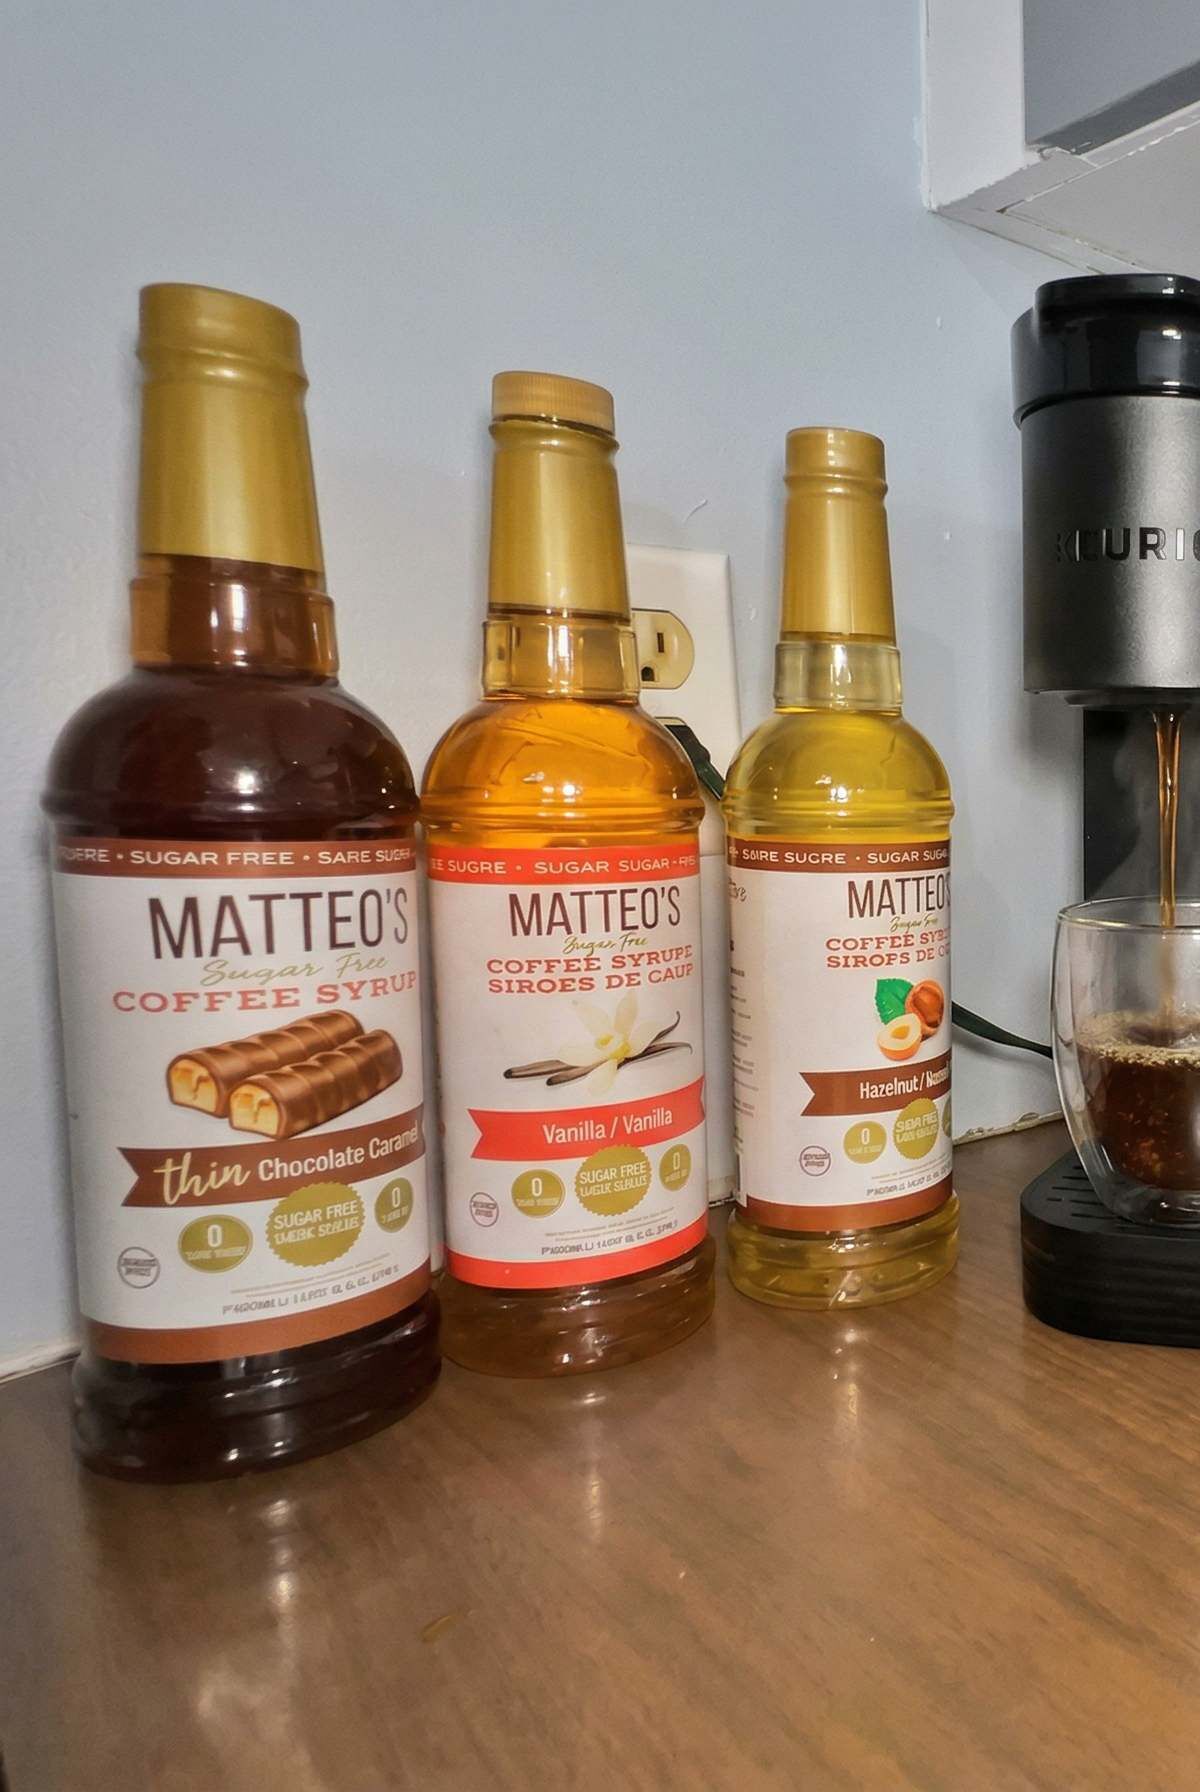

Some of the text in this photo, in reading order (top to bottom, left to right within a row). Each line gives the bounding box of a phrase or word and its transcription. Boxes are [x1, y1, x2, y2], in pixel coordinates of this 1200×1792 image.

[130, 850, 219, 865] SUGAR
[226, 851, 295, 866] FREE
[318, 850, 372, 864] SARE
[534, 861, 610, 875] SUGAR
[618, 858, 670, 872] SUGAR
[784, 852, 847, 865] SUCRE
[867, 850, 920, 864] SUGAR
[508, 885, 681, 937] MATTEO'S
[148, 887, 408, 960] MATTEO'S
[825, 934, 915, 951] COFFEE
[916, 947, 935, 962] DE
[200, 951, 388, 987] Sugar Free
[486, 956, 602, 975] COFFEE
[112, 970, 417, 1013] COFFEE SYRUP
[605, 972, 642, 990] DE
[859, 1074, 919, 1100] Hazelnut
[542, 1108, 673, 1144] Vanilla / Vanilla
[152, 1120, 420, 1206] thin Chocolate Caramel
[579, 1166, 617, 1184] SUGAR
[620, 1161, 647, 1177] FREE
[273, 1208, 323, 1230] SUGAR
[325, 1200, 359, 1219] FREE
